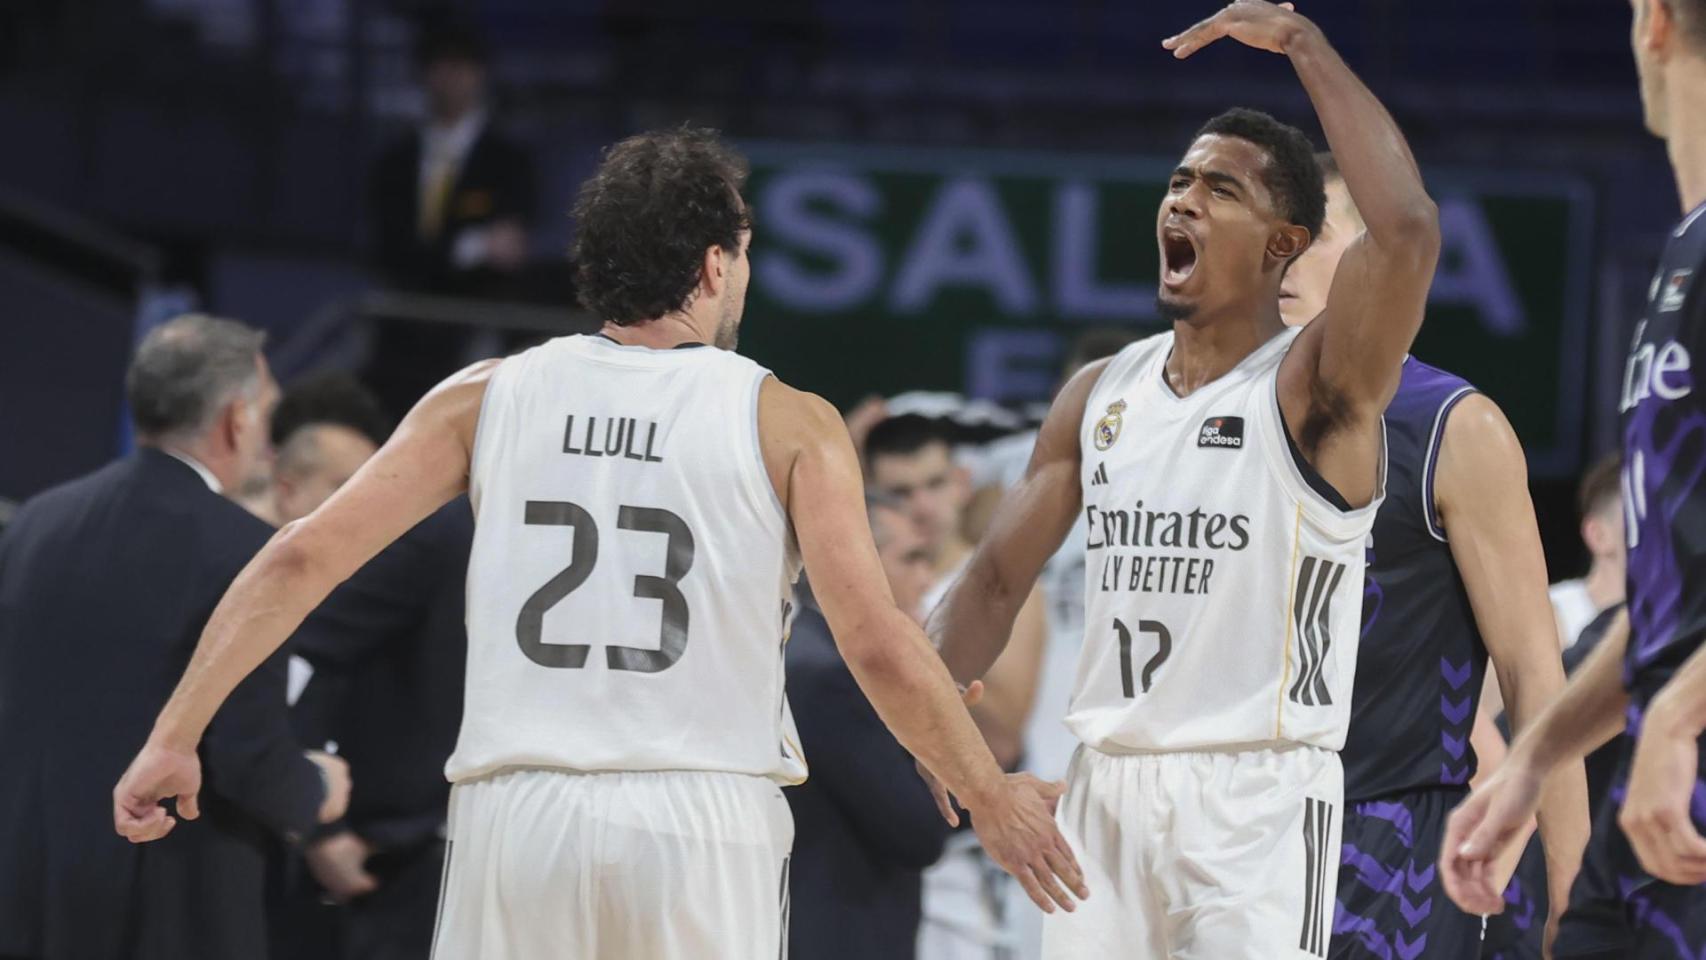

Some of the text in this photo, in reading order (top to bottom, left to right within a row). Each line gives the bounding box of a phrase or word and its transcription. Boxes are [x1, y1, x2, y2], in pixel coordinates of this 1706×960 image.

[562, 414, 663, 463] LLULL
[1200, 435, 1241, 446] endesa
[1086, 500, 1250, 552] Emirates
[515, 500, 695, 674] 23
[1128, 556, 1214, 595] BETTER
[1112, 617, 1173, 699] 12
